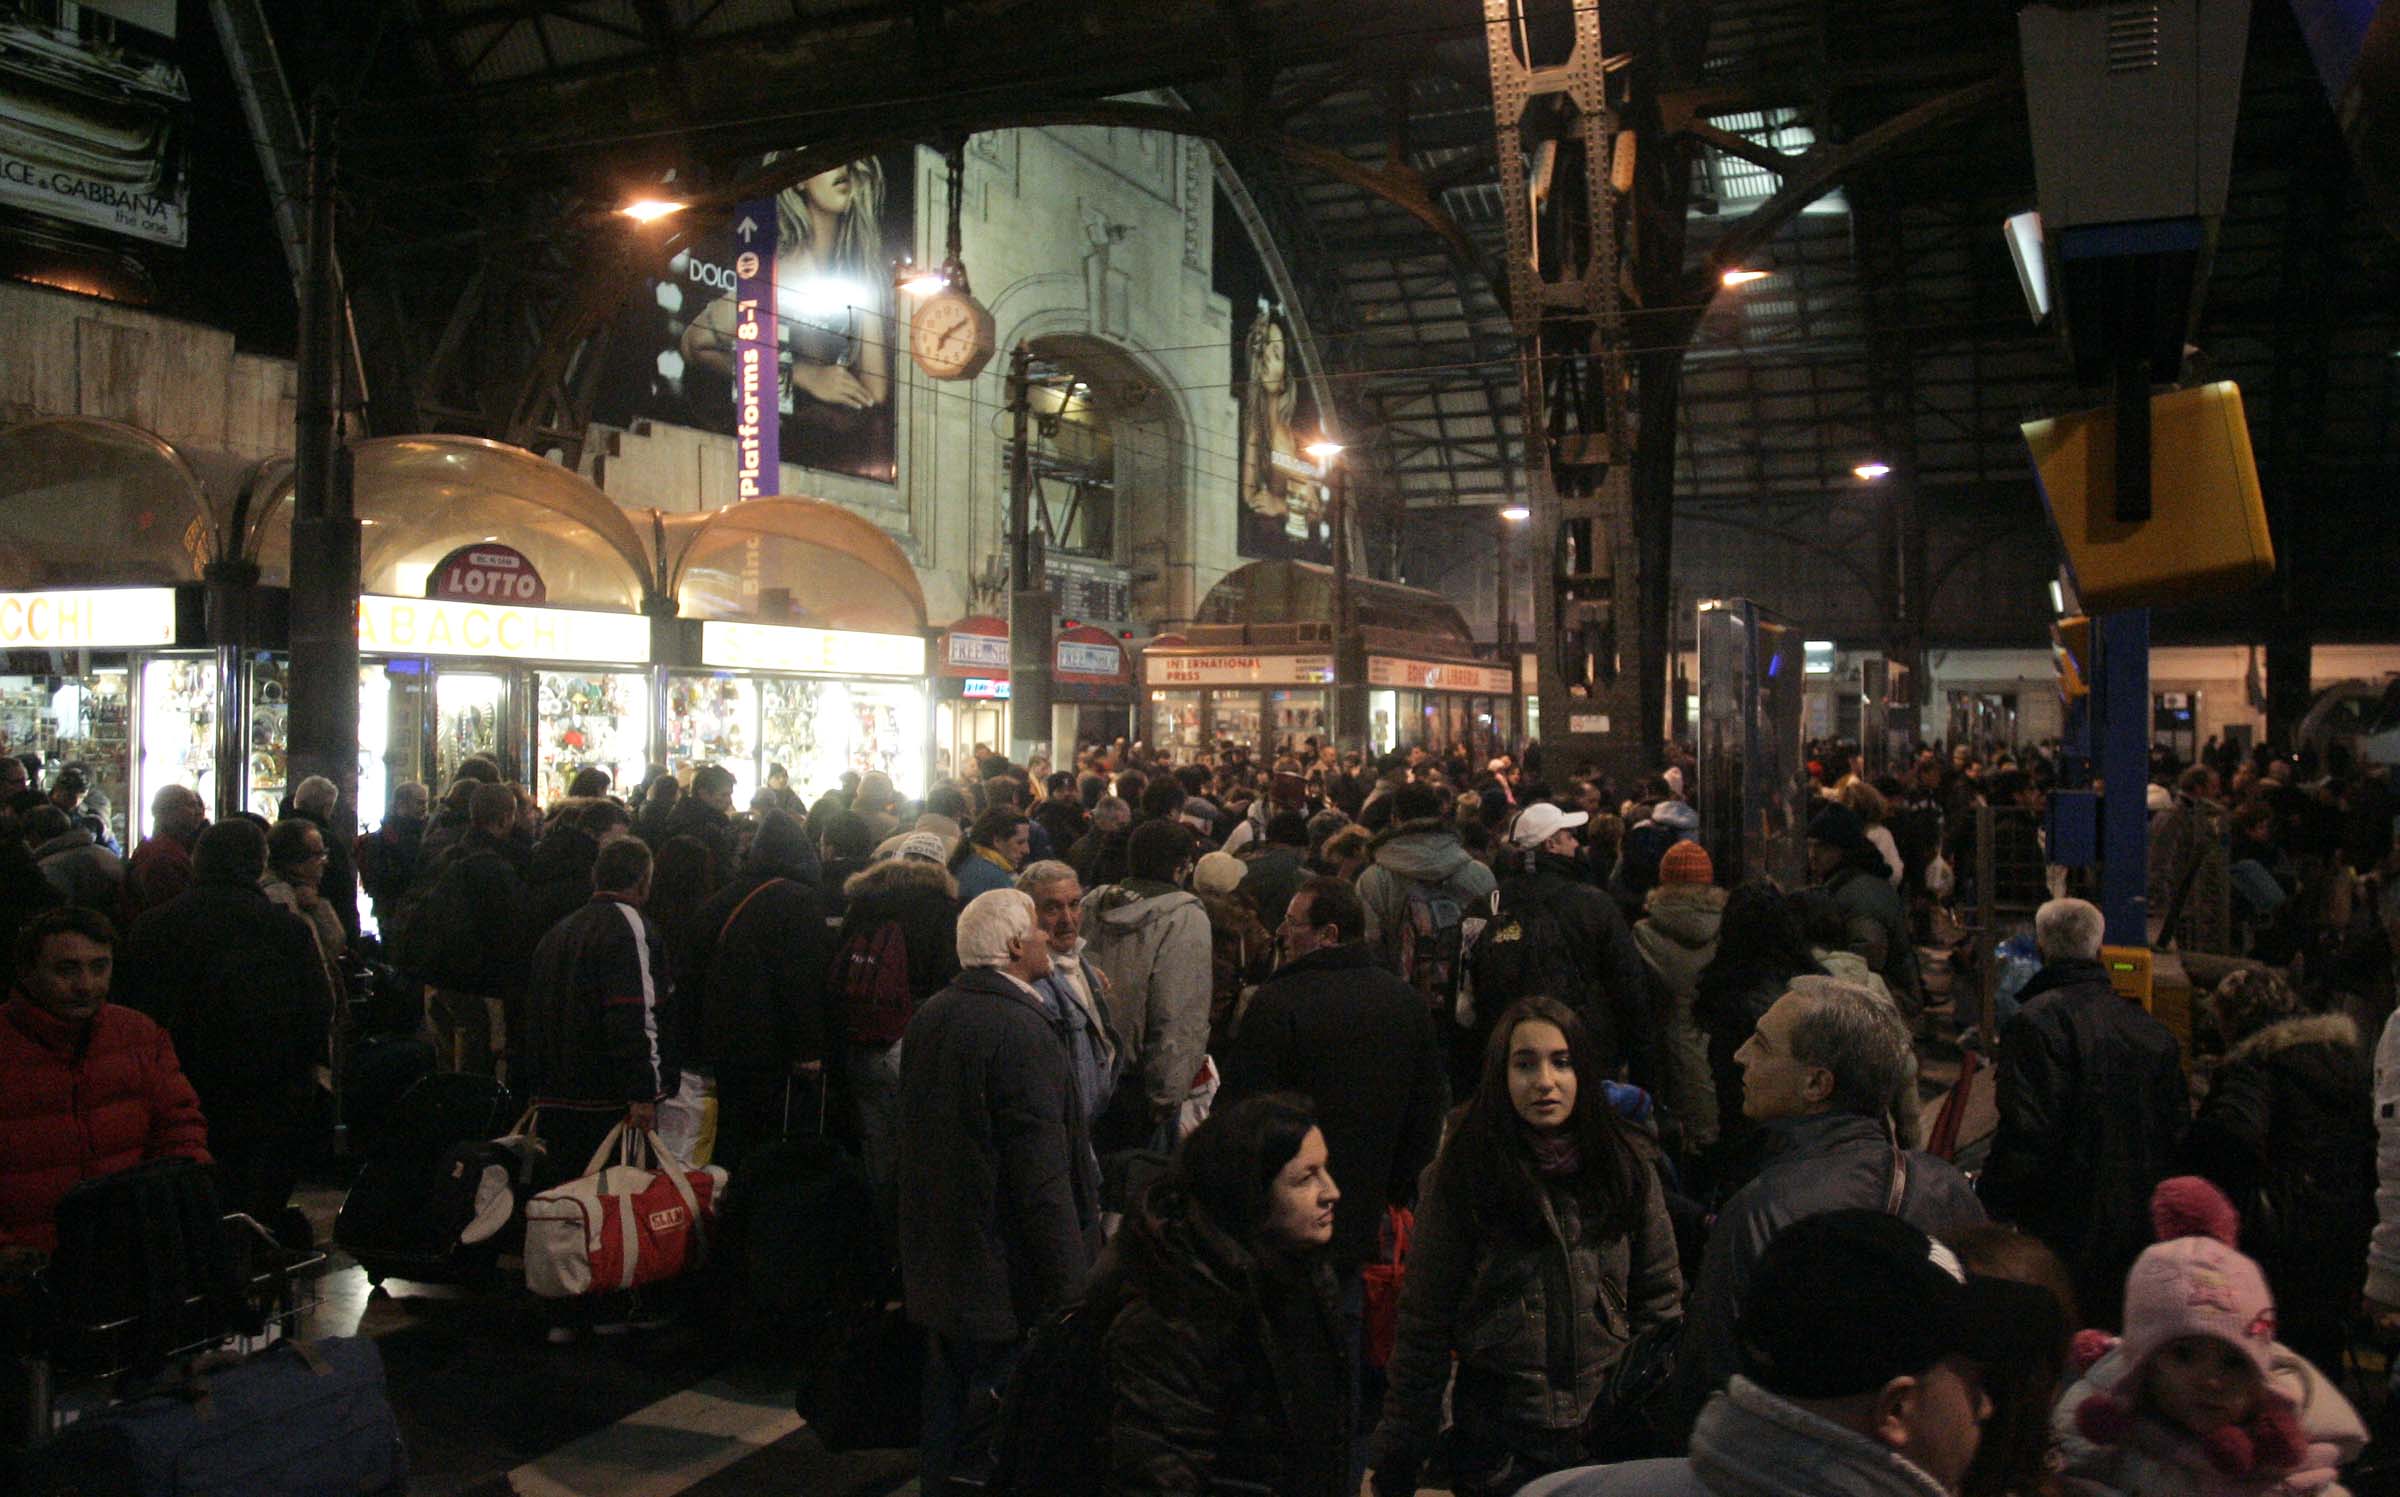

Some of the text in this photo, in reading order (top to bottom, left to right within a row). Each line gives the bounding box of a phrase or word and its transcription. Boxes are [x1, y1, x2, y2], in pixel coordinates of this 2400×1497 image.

[52, 172, 168, 219] GABBANA
[115, 208, 169, 235] the one
[738, 297, 759, 341] 8-1
[738, 347, 759, 495] Platforms
[447, 567, 537, 599] LOTTO
[952, 639, 983, 660] FREE
[1167, 658, 1262, 670] INTERNATIONAL
[1167, 671, 1201, 681] PRESS
